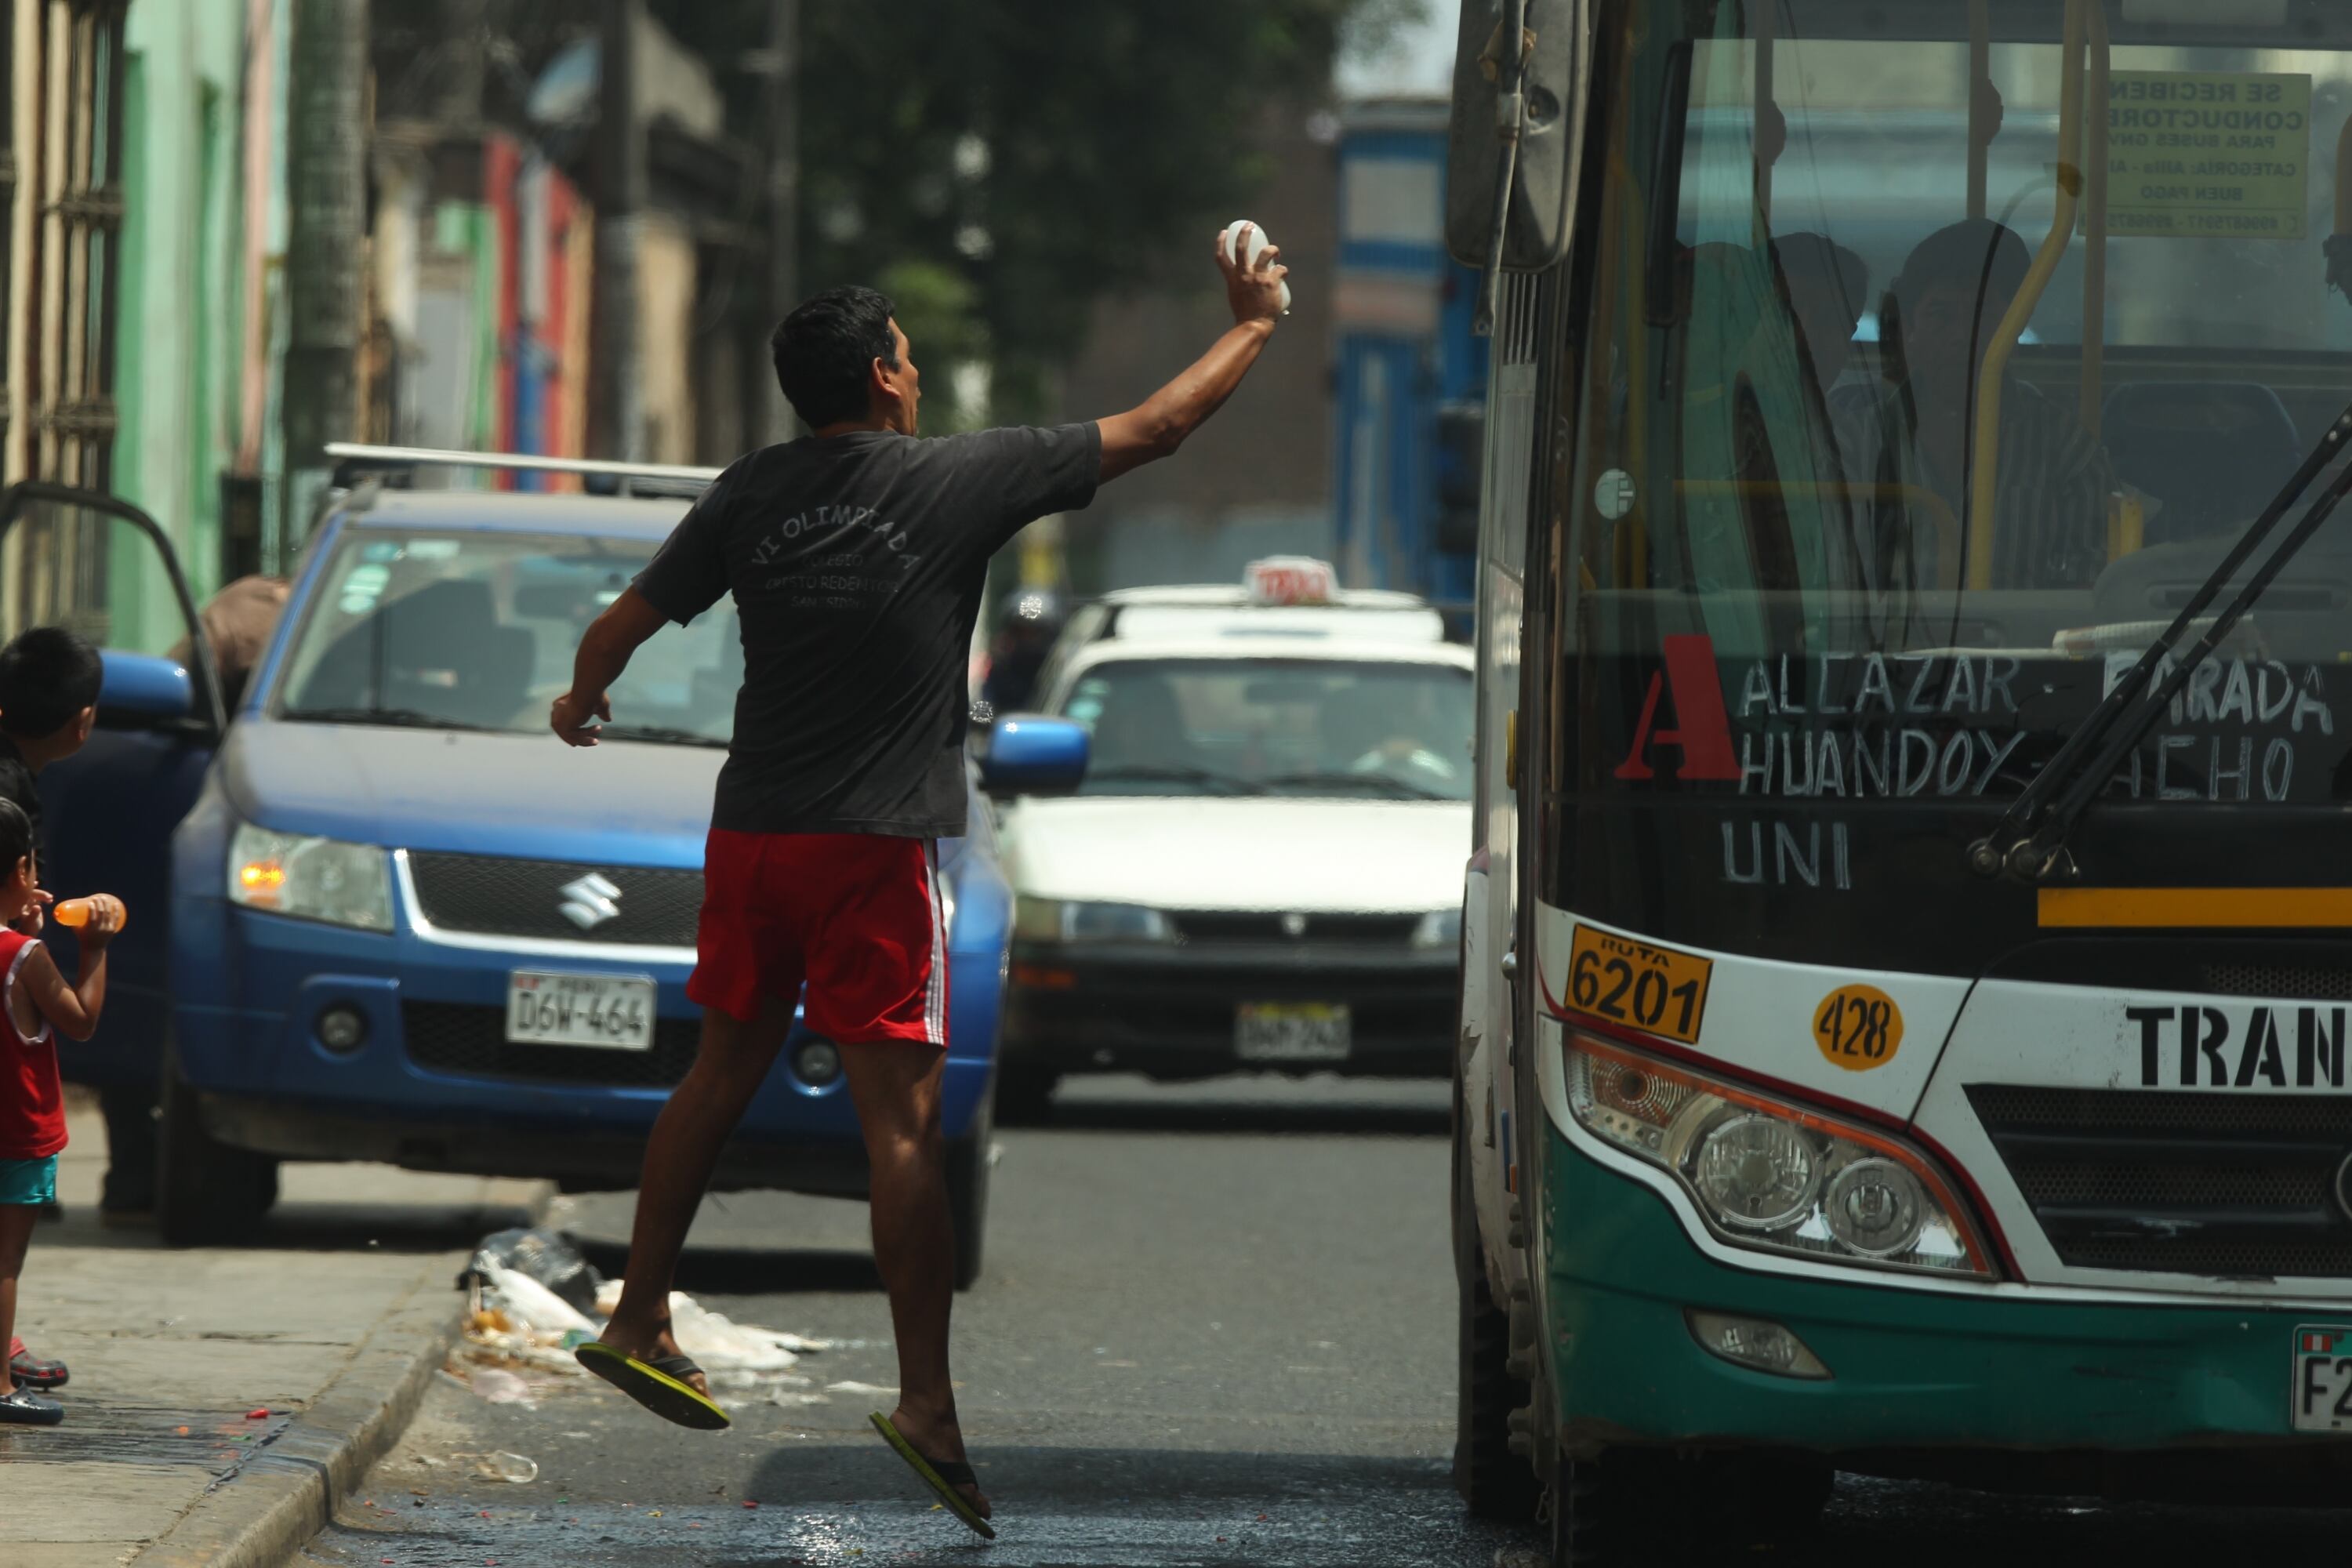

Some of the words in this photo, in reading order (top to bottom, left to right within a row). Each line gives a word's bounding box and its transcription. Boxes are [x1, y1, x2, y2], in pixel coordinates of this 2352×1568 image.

[751, 535, 781, 565] VI
[782, 504, 921, 570] OLIMPIADA
[1613, 634, 1745, 779] A
[1737, 652, 2020, 717] ALCAZAR
[1738, 729, 2028, 797] HUANDOY
[1720, 822, 1851, 890] UNI
[1601, 938, 1670, 968] RUTA
[1573, 949, 1699, 1035] 6201
[1818, 993, 1891, 1058] 428
[2125, 1006, 2346, 1088] TRAN
[2303, 1356, 2352, 1417] F2
